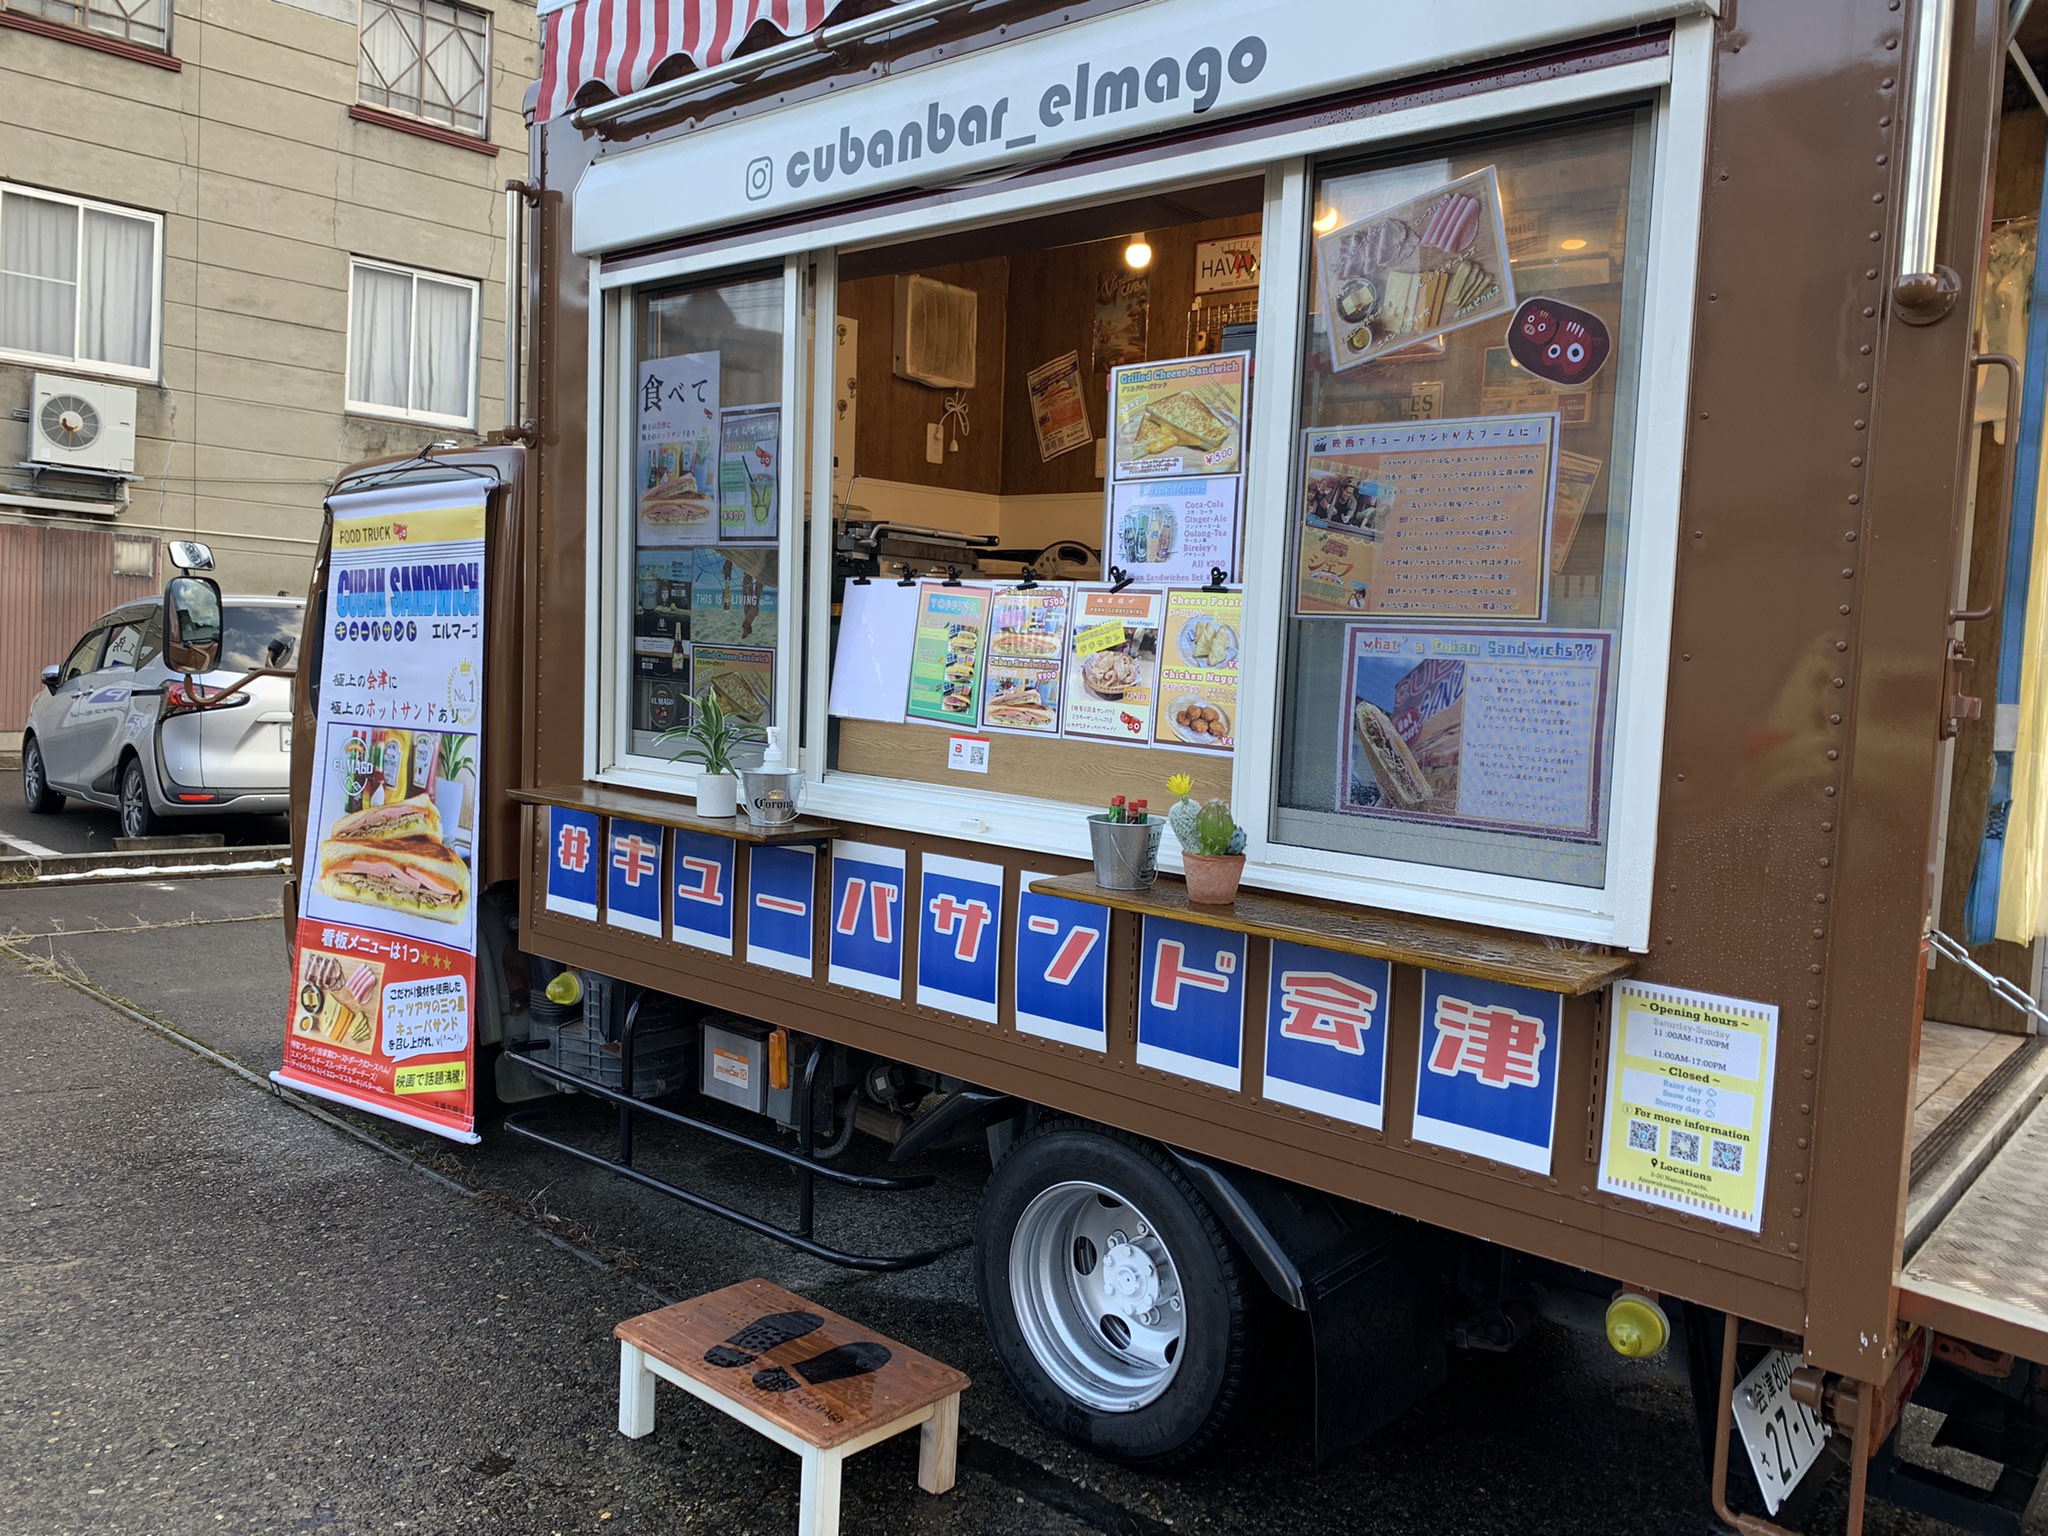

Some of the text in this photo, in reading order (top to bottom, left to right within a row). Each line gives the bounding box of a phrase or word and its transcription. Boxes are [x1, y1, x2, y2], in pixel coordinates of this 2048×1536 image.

[785, 35, 1268, 188] cubanbar_elmago
[1221, 239, 1260, 254] LITTLE
[1119, 361, 1239, 385] Grilled Cheese Sandwich
[641, 373, 709, 413] 食べて
[1205, 447, 1233, 466] ¥500
[1185, 500, 1225, 509] Coca-Cola
[1184, 515, 1228, 524] Ginger-Ale
[339, 525, 391, 544] FOOD TRUCK
[1183, 529, 1227, 539] Oolong-Tea
[1191, 560, 1226, 568] All ¥200
[1146, 573, 1188, 581] Sandwiches
[1191, 573, 1201, 581] Set
[336, 562, 479, 618] CUBAN SANDWICH
[1028, 588, 1064, 598] Sandwich
[696, 593, 712, 604] THIS
[715, 593, 723, 604] IS
[731, 594, 757, 606] LIVING
[1043, 597, 1065, 608] ¥500
[1170, 595, 1207, 606] Cheese
[335, 620, 418, 642] キューバサンド
[1432, 638, 1479, 656] Cuban
[738, 652, 770, 664] Sandwich
[989, 657, 1059, 671] Cuban Sandwiches
[333, 668, 398, 691] 極上の会津に
[1162, 669, 1203, 681] Chicken
[330, 699, 459, 723] 極上のホットサンドあり
[333, 759, 345, 771] EL
[754, 796, 793, 810] Corona
[321, 928, 420, 964] 看板メニューは1つ
[389, 981, 462, 1000] こだわり食材を使用した
[1649, 1002, 1739, 1027] Opening hours
[395, 1016, 458, 1036] キューバサンド
[1652, 1018, 1731, 1041] Saturday-Sunday
[1653, 1049, 1727, 1072] 11:00AM-17:00PM
[1668, 1066, 1710, 1085] Closed
[1662, 1079, 1703, 1096] Rainy day
[1662, 1088, 1702, 1105] Snow day
[1655, 1098, 1701, 1115] Stormy day
[1634, 1107, 1751, 1142] For more information
[1659, 1160, 1713, 1182] Locations
[1687, 1188, 1721, 1202] Fukushima
[1752, 1351, 1793, 1415] 会津 800
